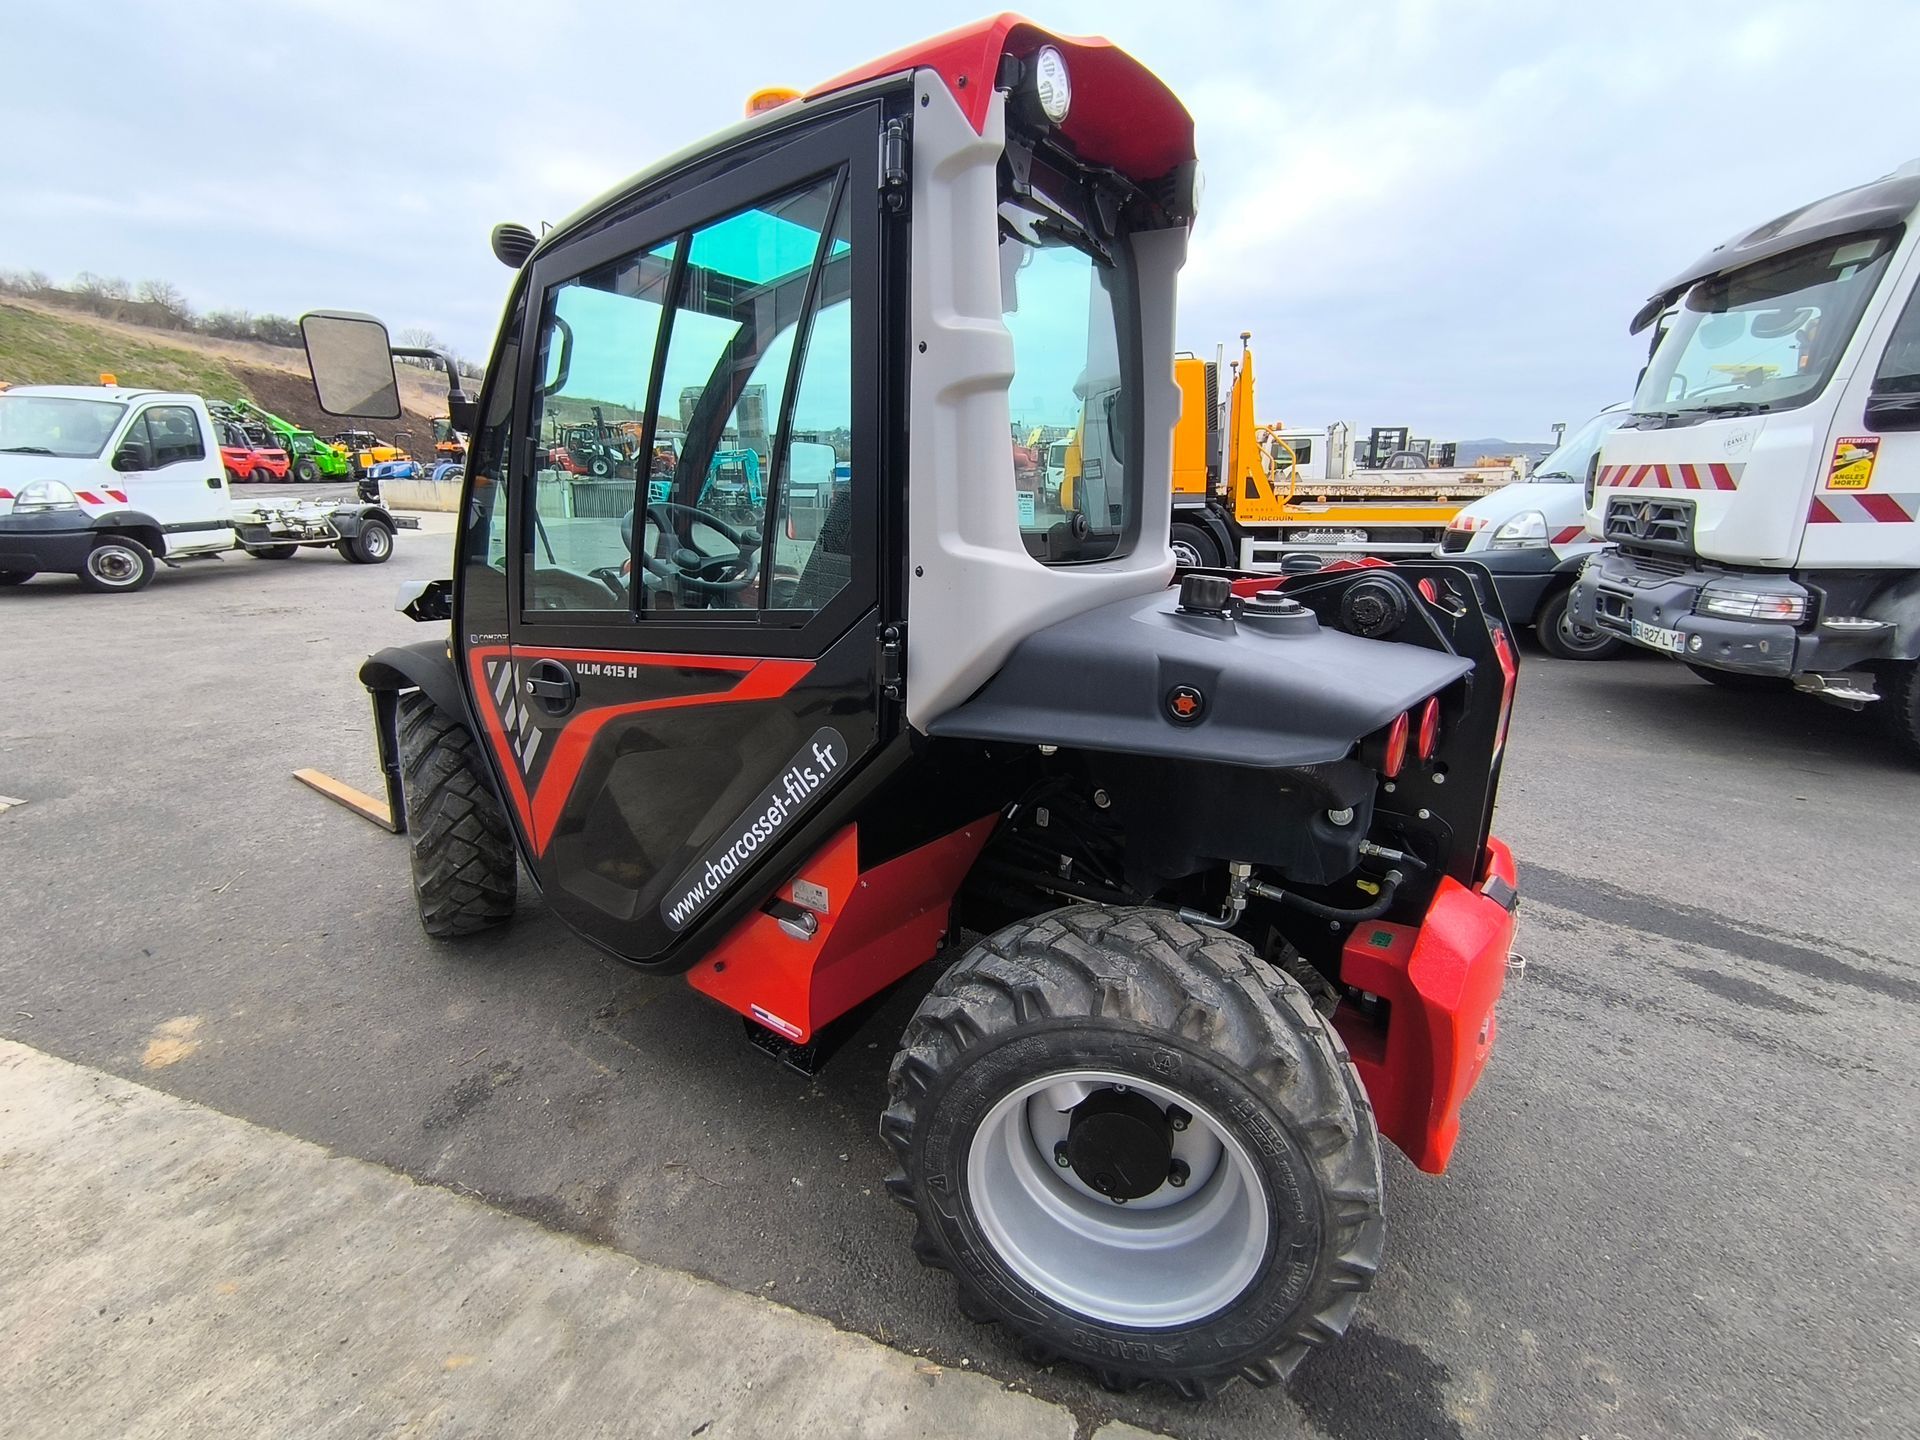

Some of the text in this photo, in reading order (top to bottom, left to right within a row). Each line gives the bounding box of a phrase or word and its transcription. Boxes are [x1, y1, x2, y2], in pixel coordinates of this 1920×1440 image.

[576, 663, 638, 679] ULM 415 H
[668, 742, 837, 925] www.charcosset-fils.fr
